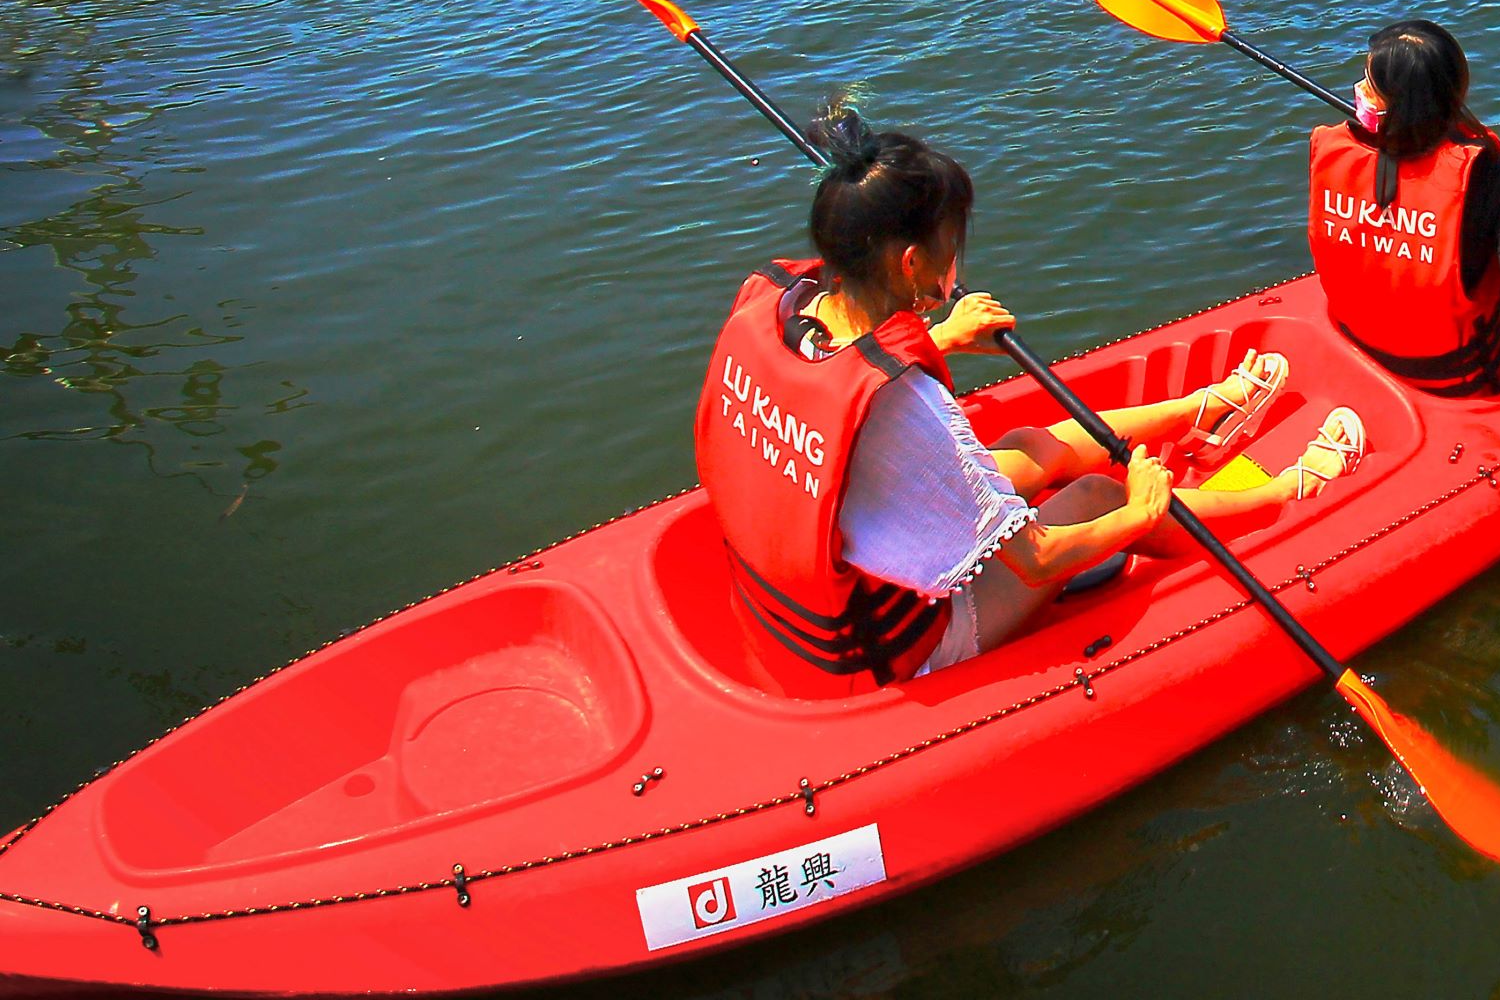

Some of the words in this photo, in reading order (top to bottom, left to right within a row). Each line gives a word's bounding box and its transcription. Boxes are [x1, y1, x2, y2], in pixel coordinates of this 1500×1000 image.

[1324, 220, 1434, 264] TAIWAN
[721, 394, 820, 499] TAIWAN
[755, 852, 838, 910] 龍興
